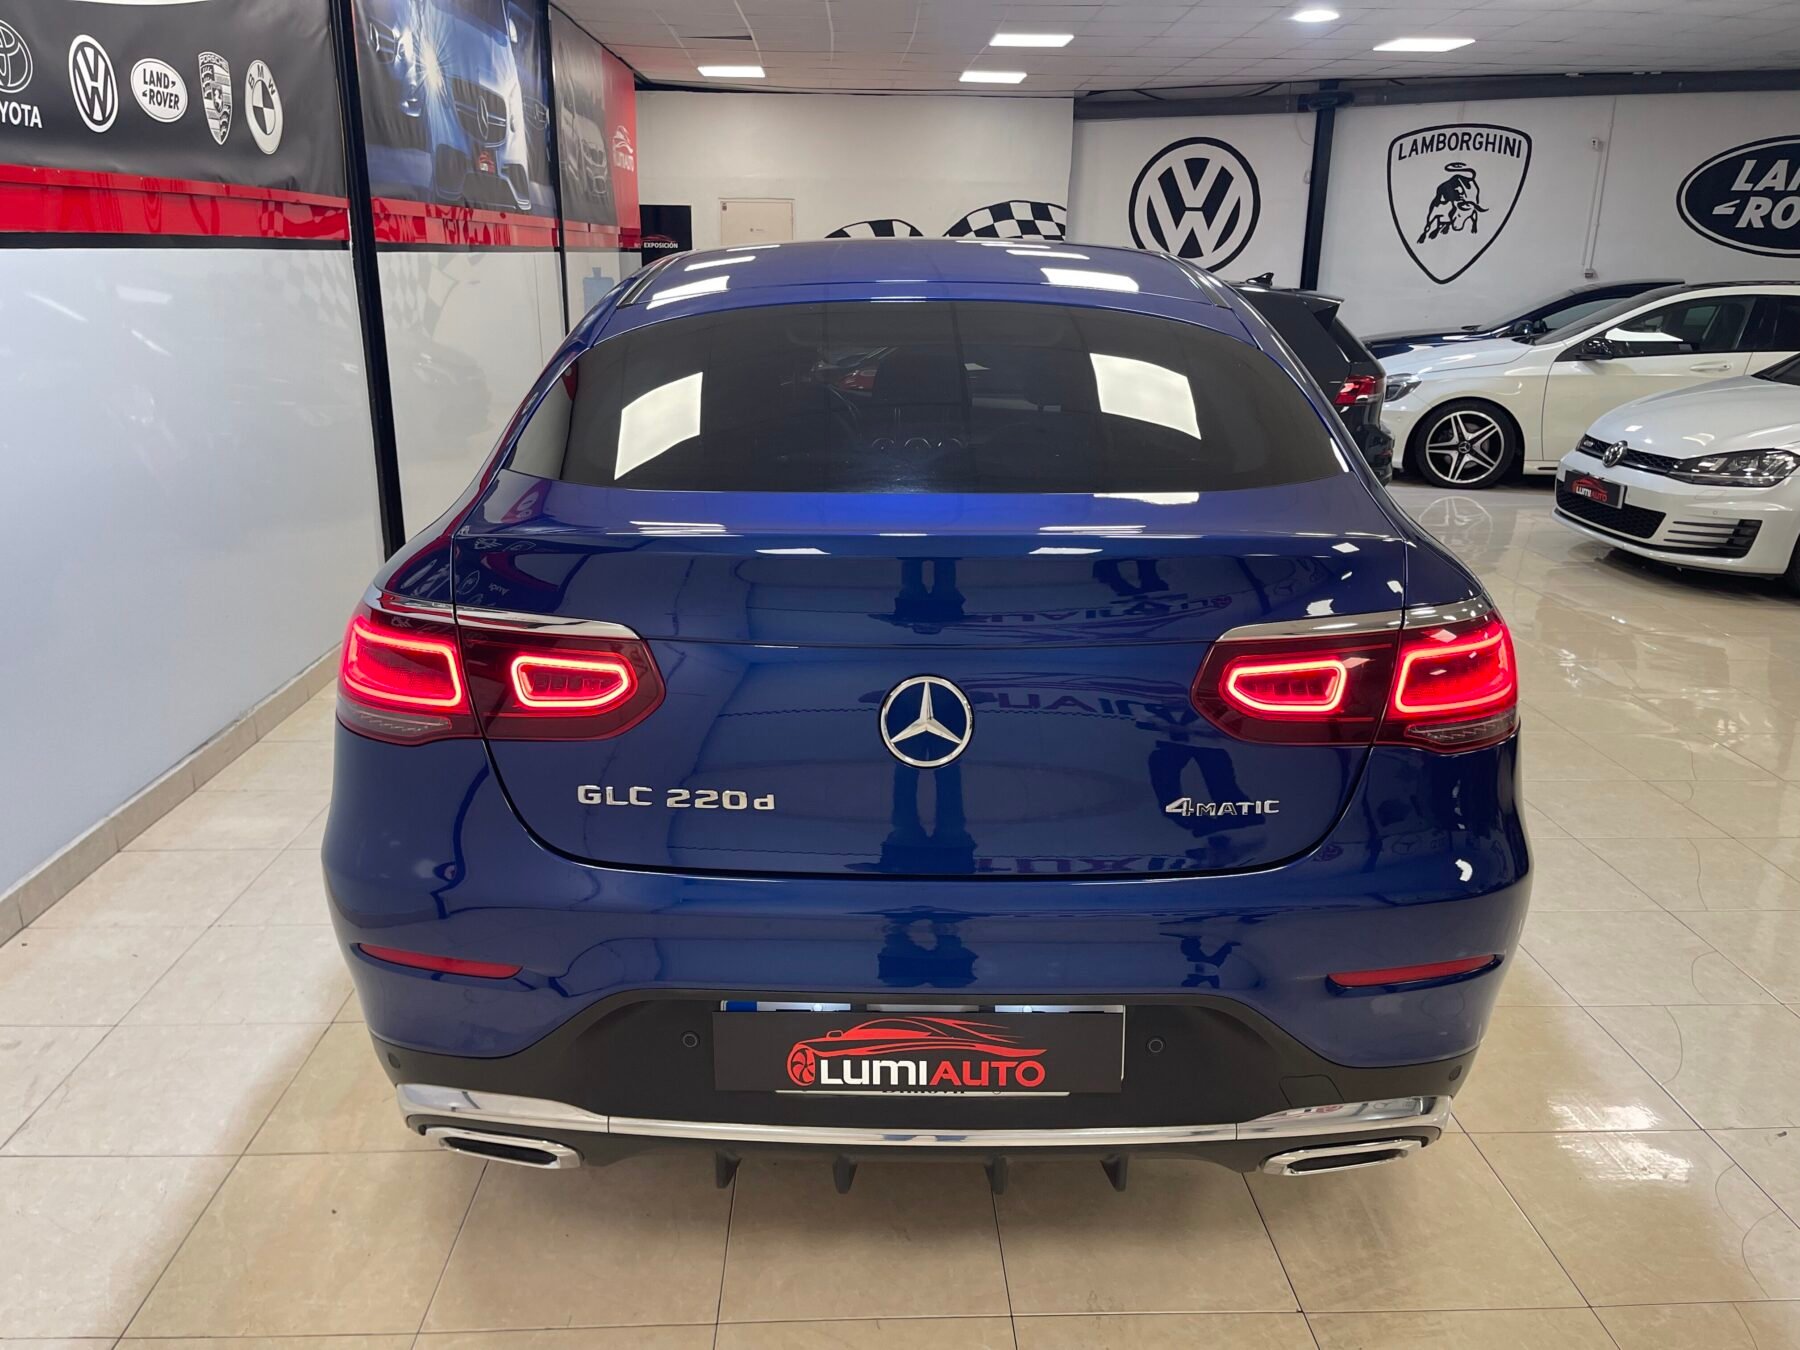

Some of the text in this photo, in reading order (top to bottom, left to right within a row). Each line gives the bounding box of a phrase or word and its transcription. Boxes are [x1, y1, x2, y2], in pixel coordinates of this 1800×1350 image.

[148, 88, 180, 111] ROVER
[1398, 132, 1522, 161] LAMBORGHINI
[577, 784, 775, 810] GLC 220d
[1165, 797, 1280, 817] 4MATIC
